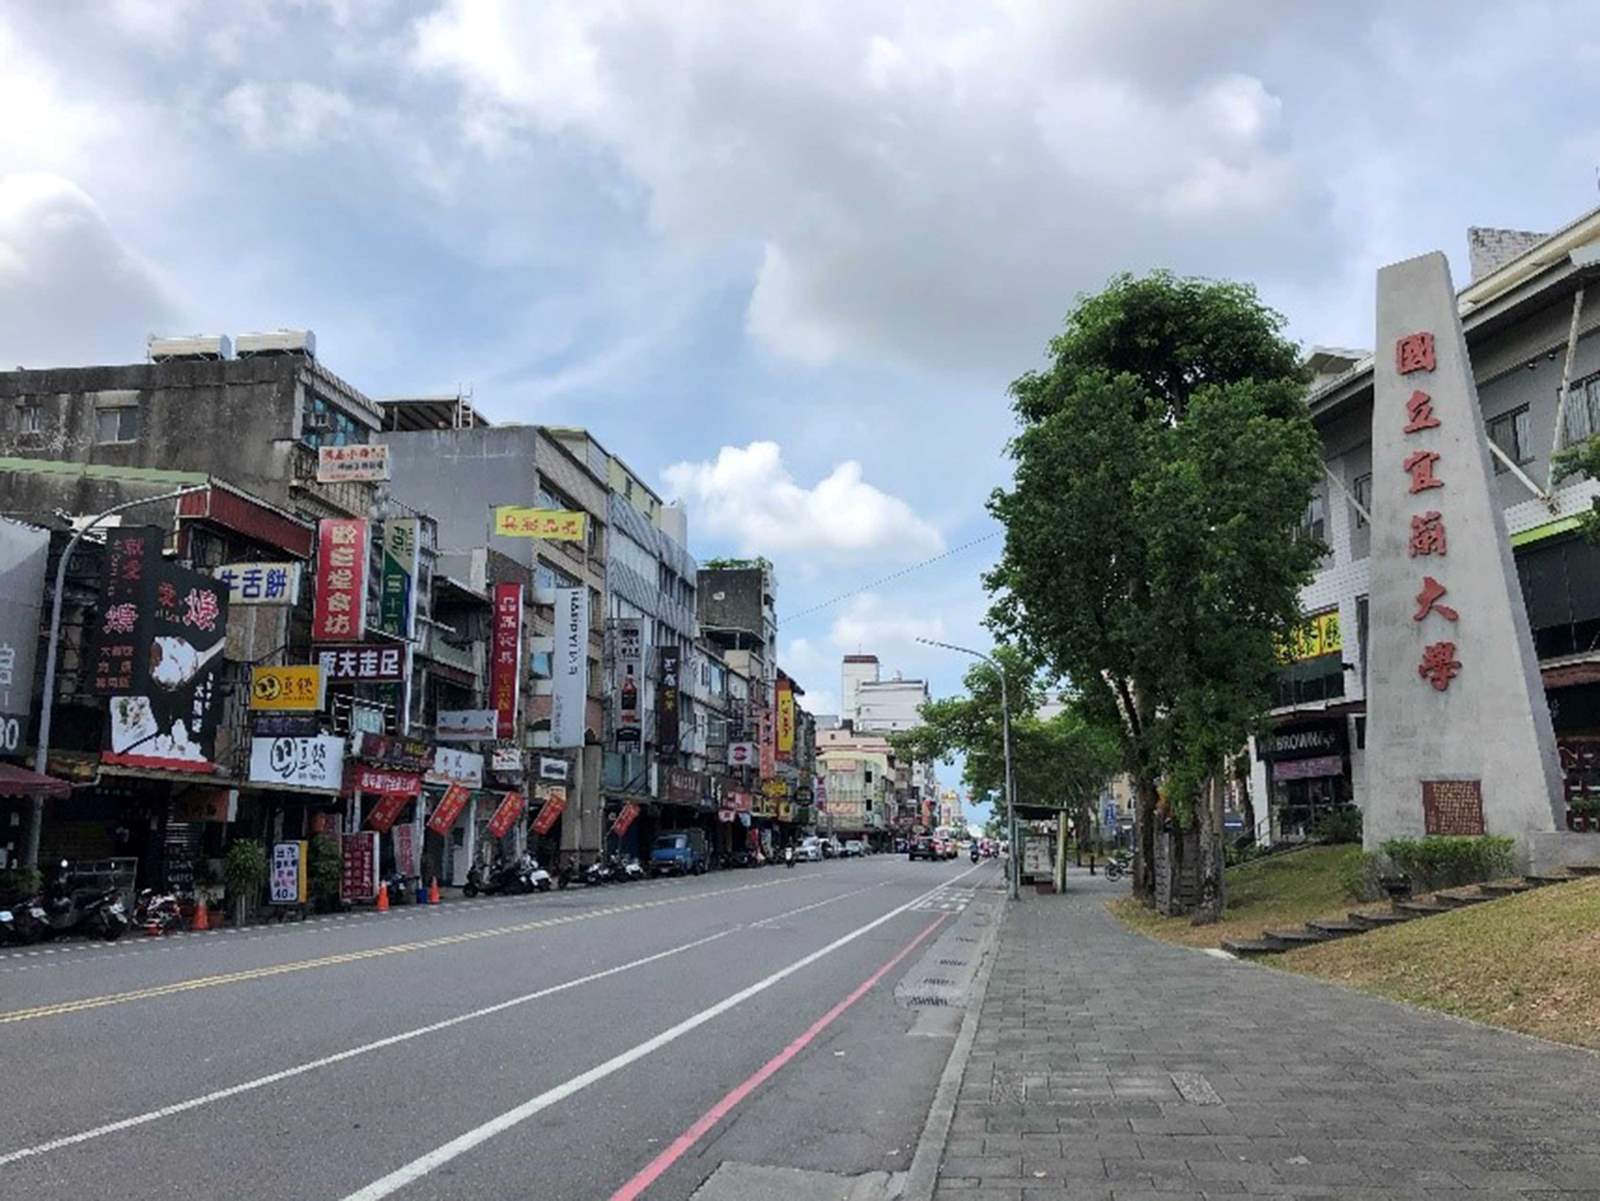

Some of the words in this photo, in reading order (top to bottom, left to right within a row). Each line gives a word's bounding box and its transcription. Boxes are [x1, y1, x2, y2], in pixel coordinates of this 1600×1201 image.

[1396, 331, 1462, 692] 國立宜蘭大學
